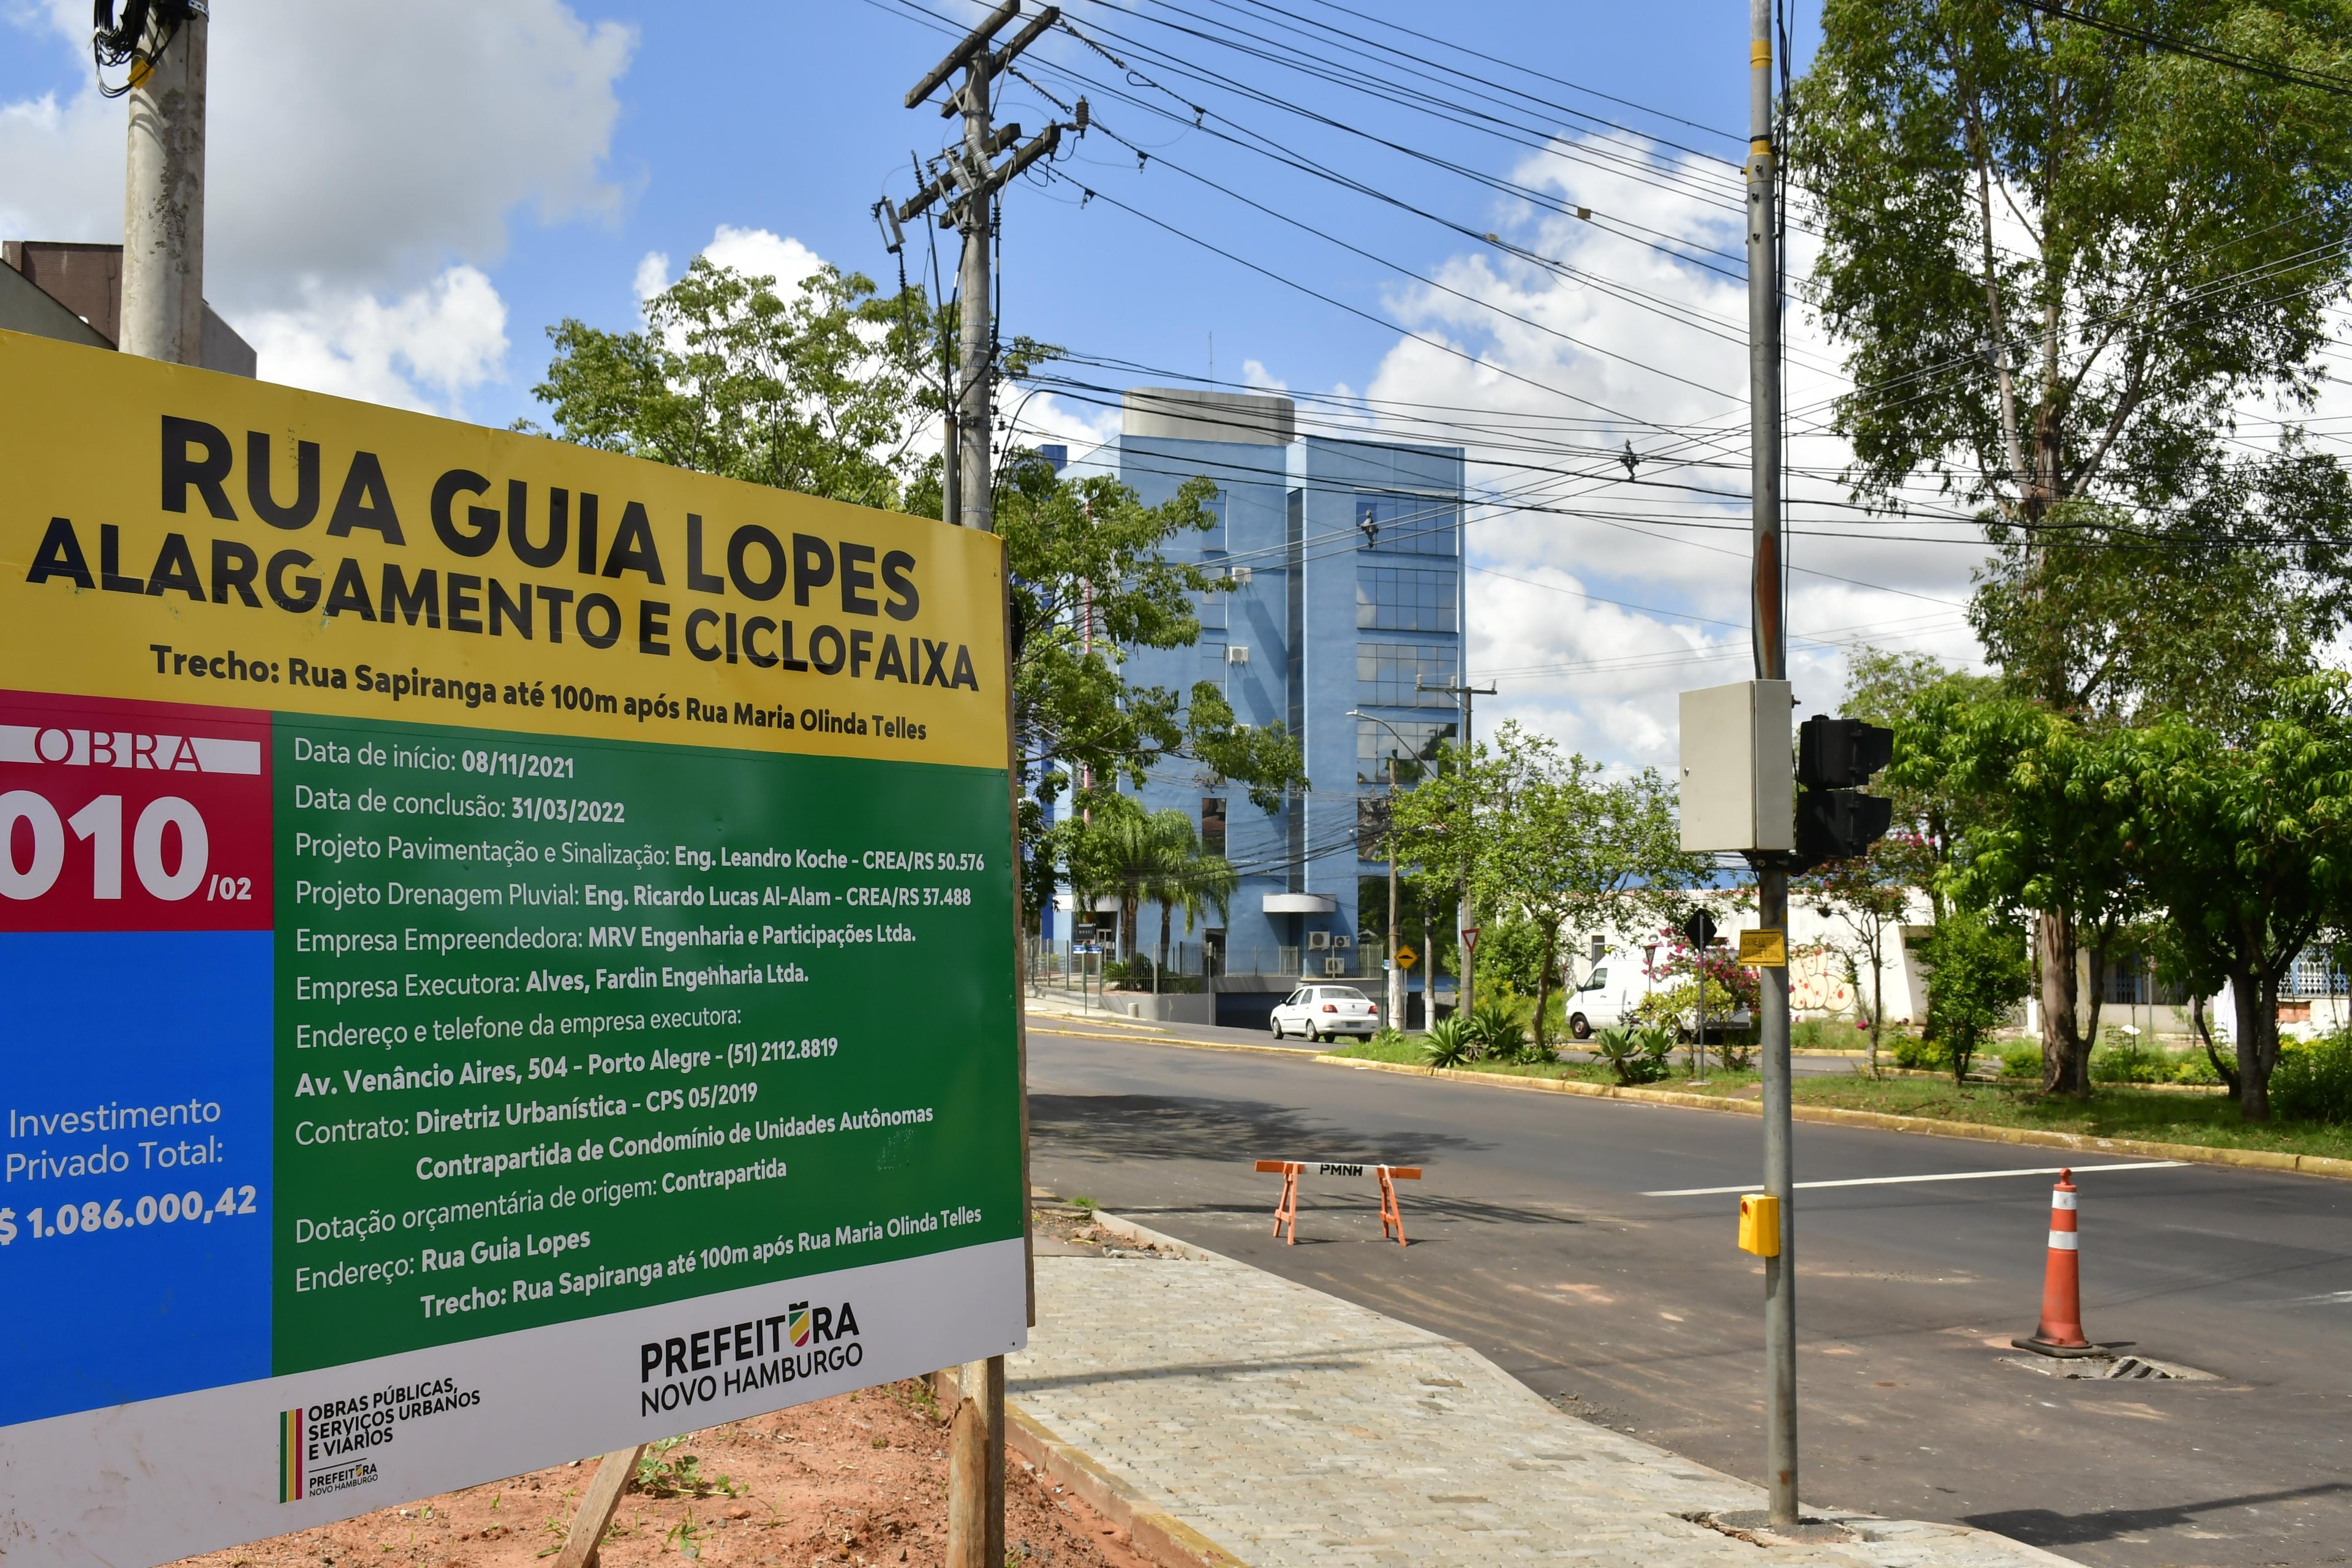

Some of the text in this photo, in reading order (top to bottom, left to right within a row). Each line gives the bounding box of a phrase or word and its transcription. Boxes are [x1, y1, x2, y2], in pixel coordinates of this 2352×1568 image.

[162, 415, 920, 622] RUA GUIA LOPES
[26, 517, 979, 691] ALARGAMENTO E CICLOFAIXA
[150, 644, 926, 740] Trecho: Rua Sapiranga até 100m após Rua Maria Olinda Telles
[34, 725, 203, 772] OBRA
[295, 737, 573, 778] Data de início: 08/11/2021
[296, 785, 624, 823] Data de conclusão: 31/03/2022
[296, 833, 380, 863] Projeto
[389, 836, 538, 867] Pavimentação
[545, 847, 556, 862] e
[562, 842, 669, 870] Sinalização:
[676, 846, 716, 871] Eng.
[722, 847, 791, 867] Leandro
[796, 850, 847, 868] Koche
[863, 851, 933, 872] CREA/RS
[938, 853, 984, 870] 50.576
[297, 881, 380, 910] Projeto
[389, 883, 502, 911] Drenagem
[510, 883, 578, 905] Pluvial:
[586, 885, 628, 911] Eng.
[634, 884, 704, 905] Ricardo
[710, 886, 758, 905] Lucas
[763, 886, 830, 905] Al-Alam
[847, 887, 919, 908] CREA/RS
[924, 888, 971, 905] 37.488
[298, 923, 916, 957] Empresa Empreendedora: MRV Engenharia e Participações Ltda.
[298, 963, 809, 1005] Empresa Executora: Alves, Fardin Engenharia Ltda.
[298, 1008, 741, 1050] Endereço e telefone da empresa executora:
[295, 1073, 337, 1096] Av.
[344, 1063, 453, 1093] Venâncio
[459, 1060, 522, 1084] Aires,
[529, 1057, 567, 1079] 504
[589, 1053, 645, 1074] Porto
[650, 1049, 710, 1073] Alegre
[728, 1042, 757, 1068] (51)
[761, 1038, 837, 1061] 2112.8819
[11, 1099, 221, 1137] Investimento
[296, 1117, 409, 1145] Contrato:
[417, 1104, 500, 1134] Diretriz
[507, 1095, 626, 1125] Urbanística
[646, 1090, 684, 1112] CPS
[688, 1082, 757, 1108] 05/2019
[7, 1136, 222, 1182] Privado Total:
[417, 1108, 933, 1180] Contrapartida de Condomínio de Unidades Autônomas
[1320, 1164, 1363, 1177] PMNH
[27, 1185, 255, 1238] 1.086.000,42
[297, 1158, 786, 1243] Dotação orçamentária de origem: Contrapartida
[297, 1232, 590, 1292] Endereço: Rua Guia Lopes
[421, 1207, 981, 1317] Trecho: Rua Sapiranga até 100m após Rua Maria Olinda Telles
[309, 1378, 458, 1422] OBRAS PÚBLICAS,
[642, 1343, 862, 1417] NOVO HAMBURGO
[309, 1390, 480, 1441] SERVIÇOS URBANOS
[309, 1427, 393, 1460] E VIÁRIOS
[309, 1474, 379, 1498] NOVO HAMBURGO
